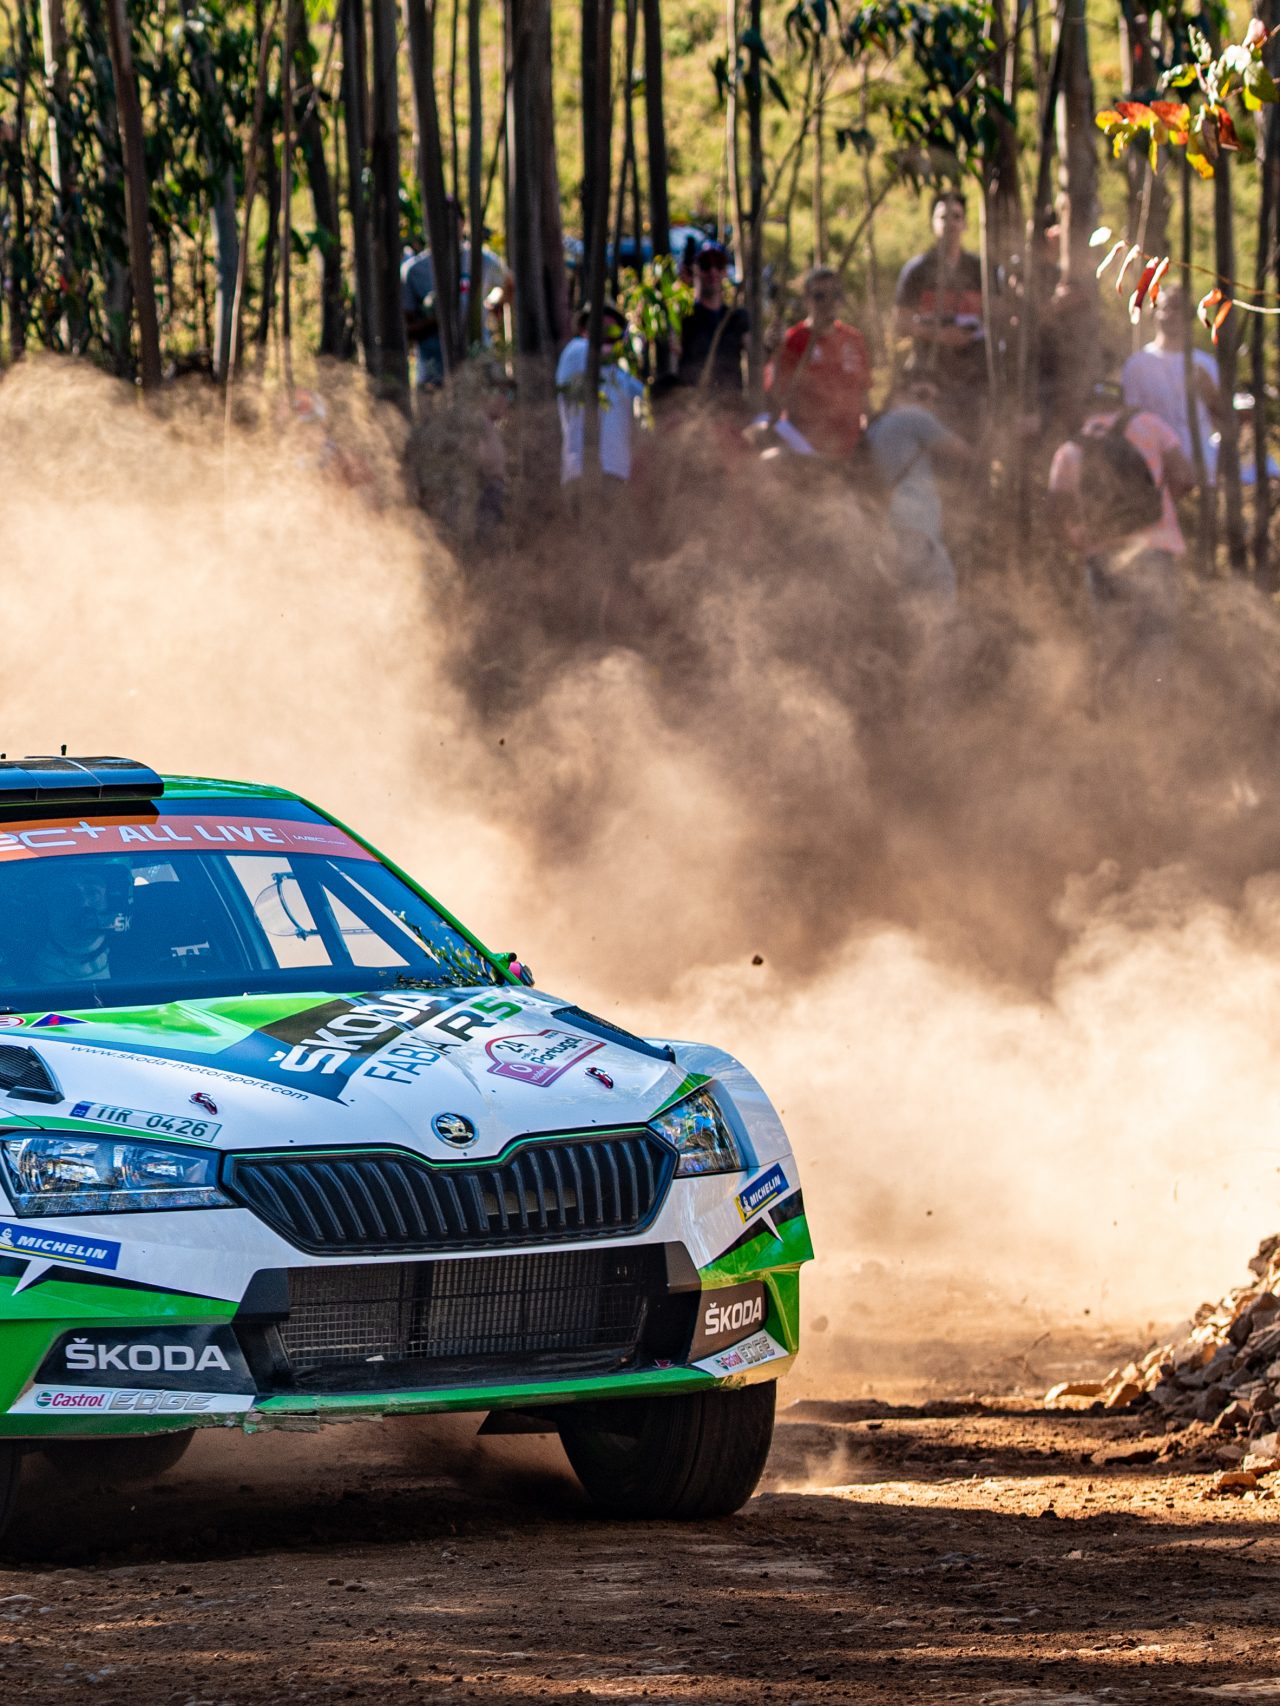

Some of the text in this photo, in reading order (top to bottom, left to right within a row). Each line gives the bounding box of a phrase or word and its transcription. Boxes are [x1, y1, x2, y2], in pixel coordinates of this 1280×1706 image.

[119, 825, 285, 844] ALL LIVE
[268, 994, 449, 1074] ŠKODA
[364, 996, 523, 1084] FABIA R5
[495, 1040, 529, 1053] 24
[71, 1046, 310, 1101] www.skoda-motorsport.com
[96, 1105, 209, 1137] 11R 0426
[750, 1174, 781, 1206] MICHELIN
[17, 1235, 108, 1260] MICHELIN
[705, 1297, 762, 1335] ŠKODA
[65, 1337, 231, 1371] ŠKODA
[52, 1390, 217, 1411] Castrol EDGE
